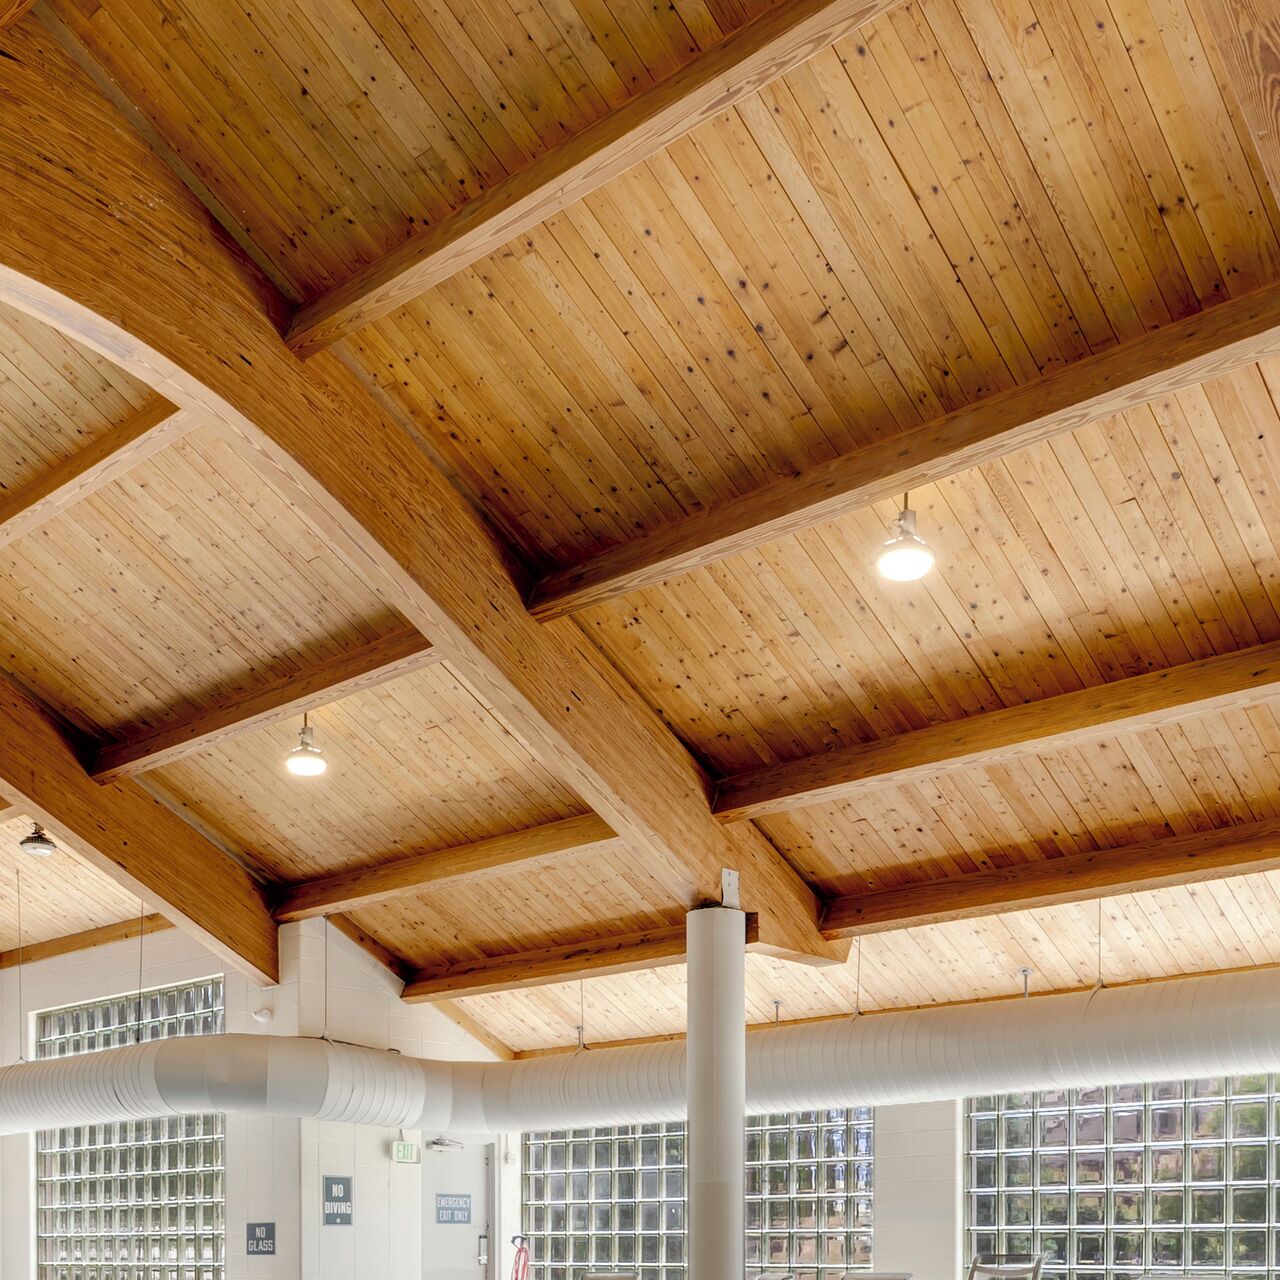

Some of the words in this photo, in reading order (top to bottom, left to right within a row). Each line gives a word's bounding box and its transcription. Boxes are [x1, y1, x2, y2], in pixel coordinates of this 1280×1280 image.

[397, 1143, 413, 1160] EXIT
[332, 1184, 344, 1198] NO
[325, 1202, 352, 1214] DIVING
[437, 1197, 470, 1208] EMERGENCY
[440, 1210, 452, 1220] EXIT
[454, 1211, 468, 1220] ONLY
[256, 1227, 266, 1238] NO
[248, 1240, 273, 1251] GLASS
